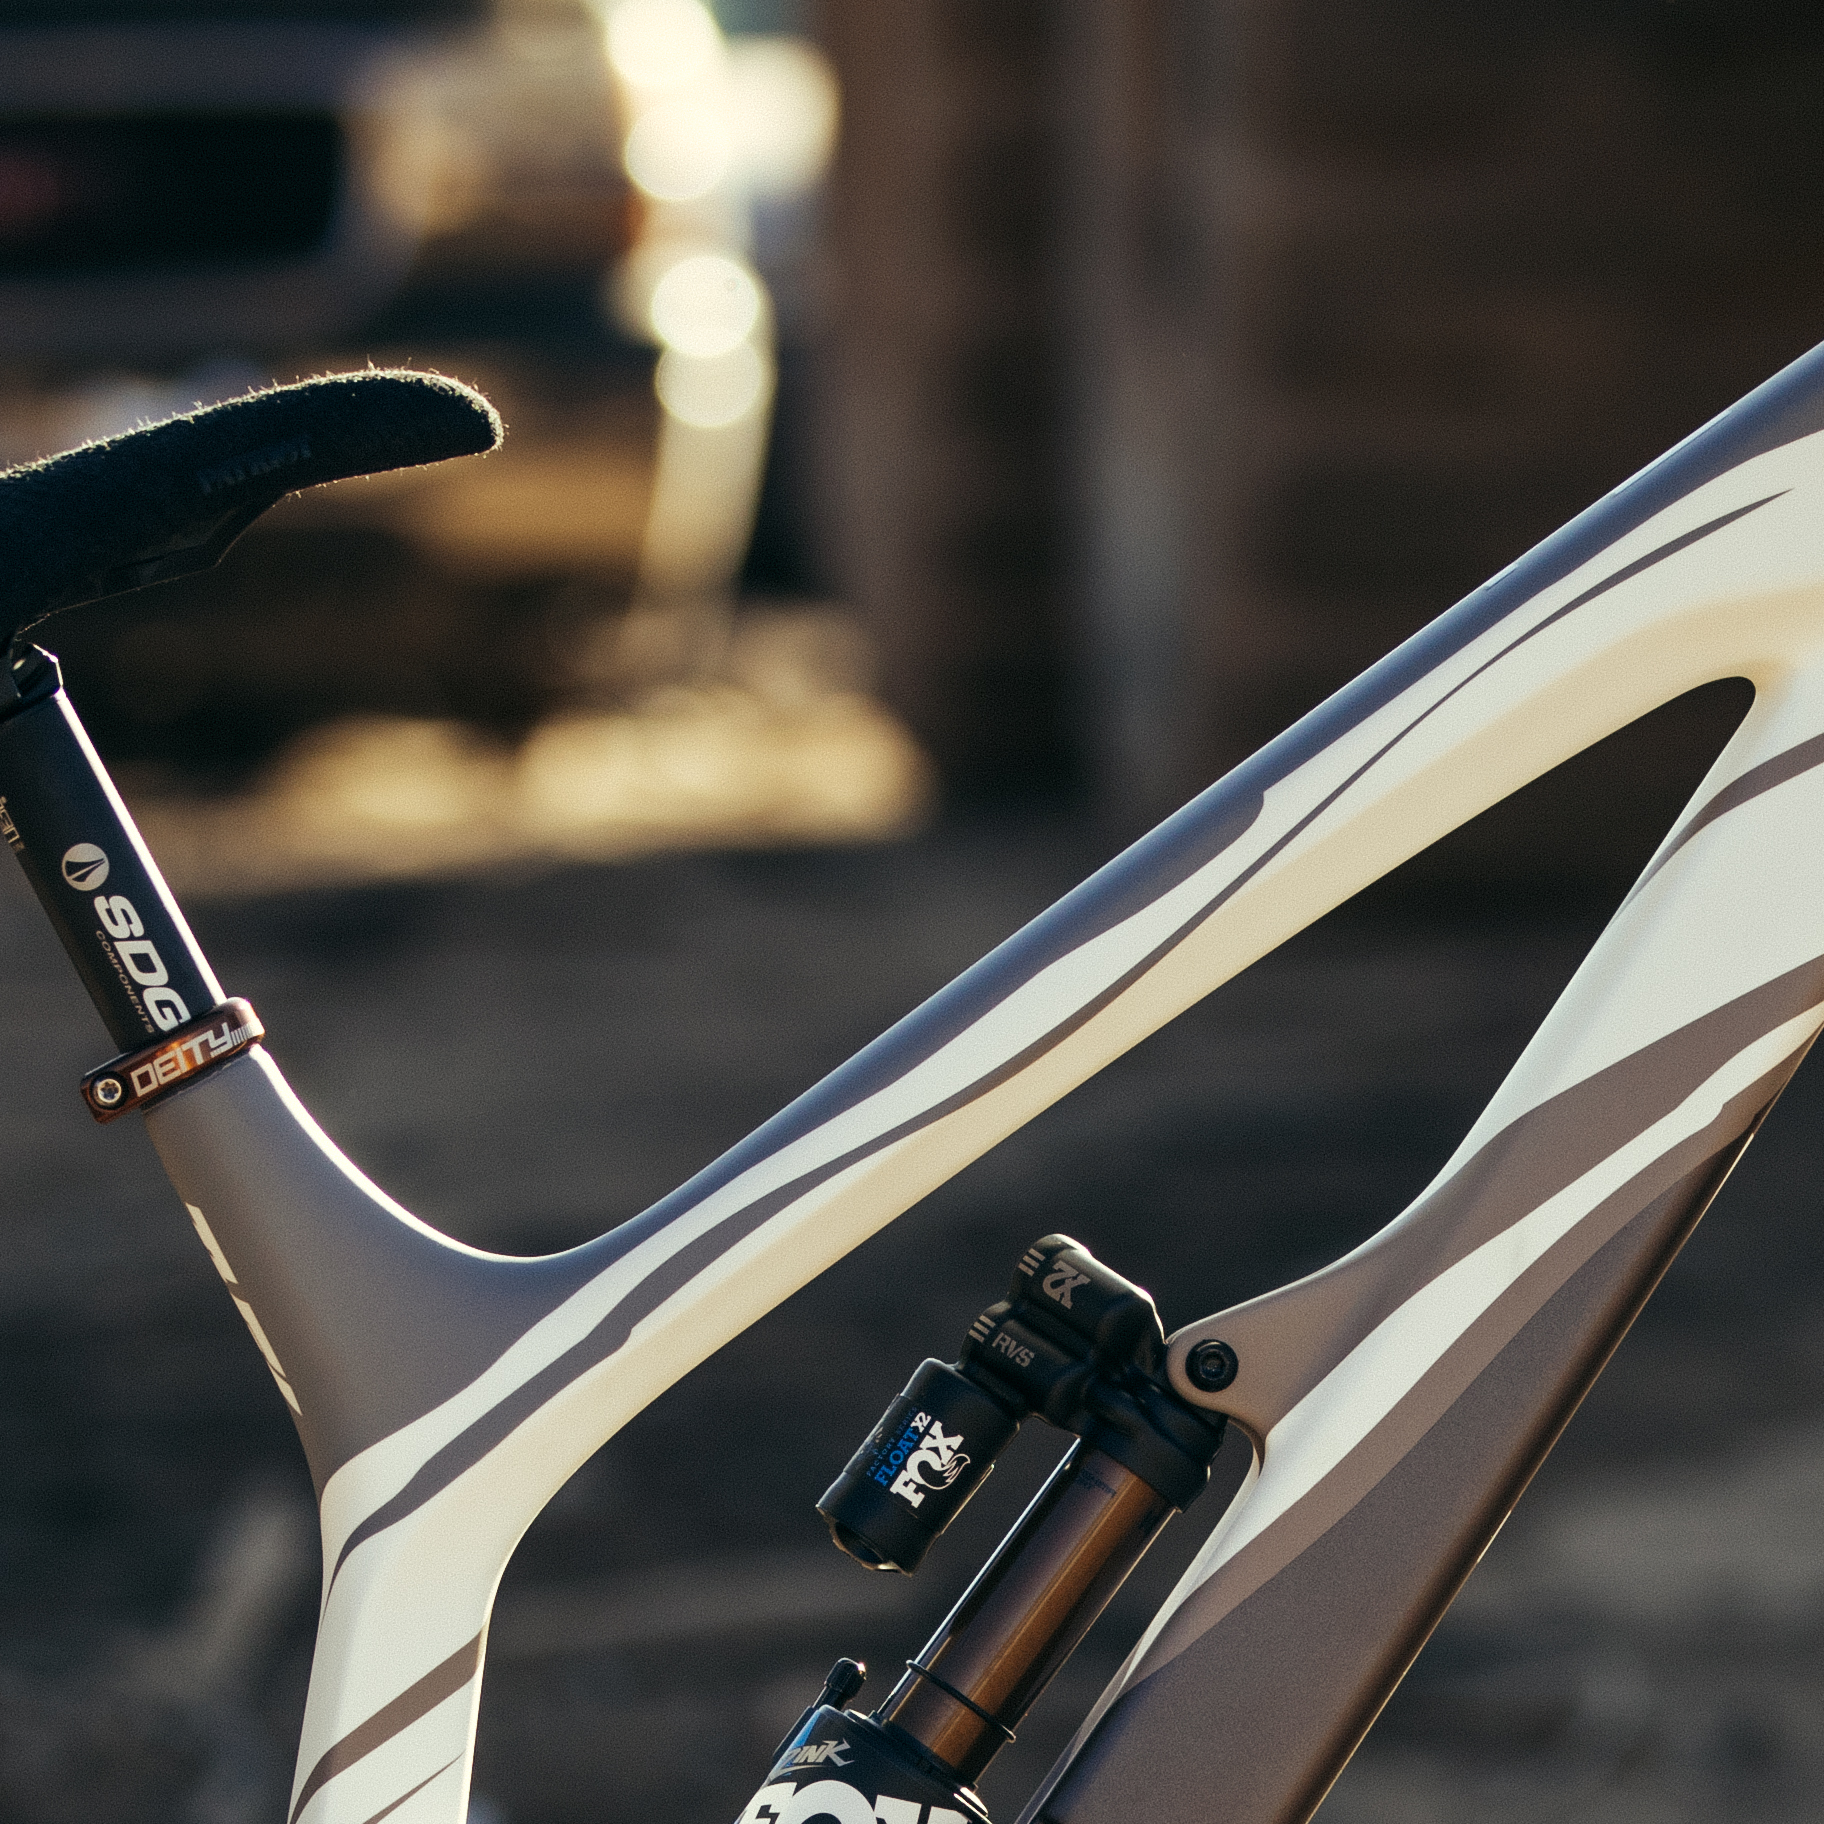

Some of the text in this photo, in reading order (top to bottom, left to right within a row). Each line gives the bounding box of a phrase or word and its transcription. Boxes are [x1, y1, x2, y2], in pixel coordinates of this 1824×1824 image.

[94, 894, 190, 1032] SDG
[95, 930, 156, 1034] COMPONENTS
[130, 1023, 235, 1097] DEITY
[874, 1426, 919, 1487] FLOAT
[890, 1420, 968, 1508] FOX
